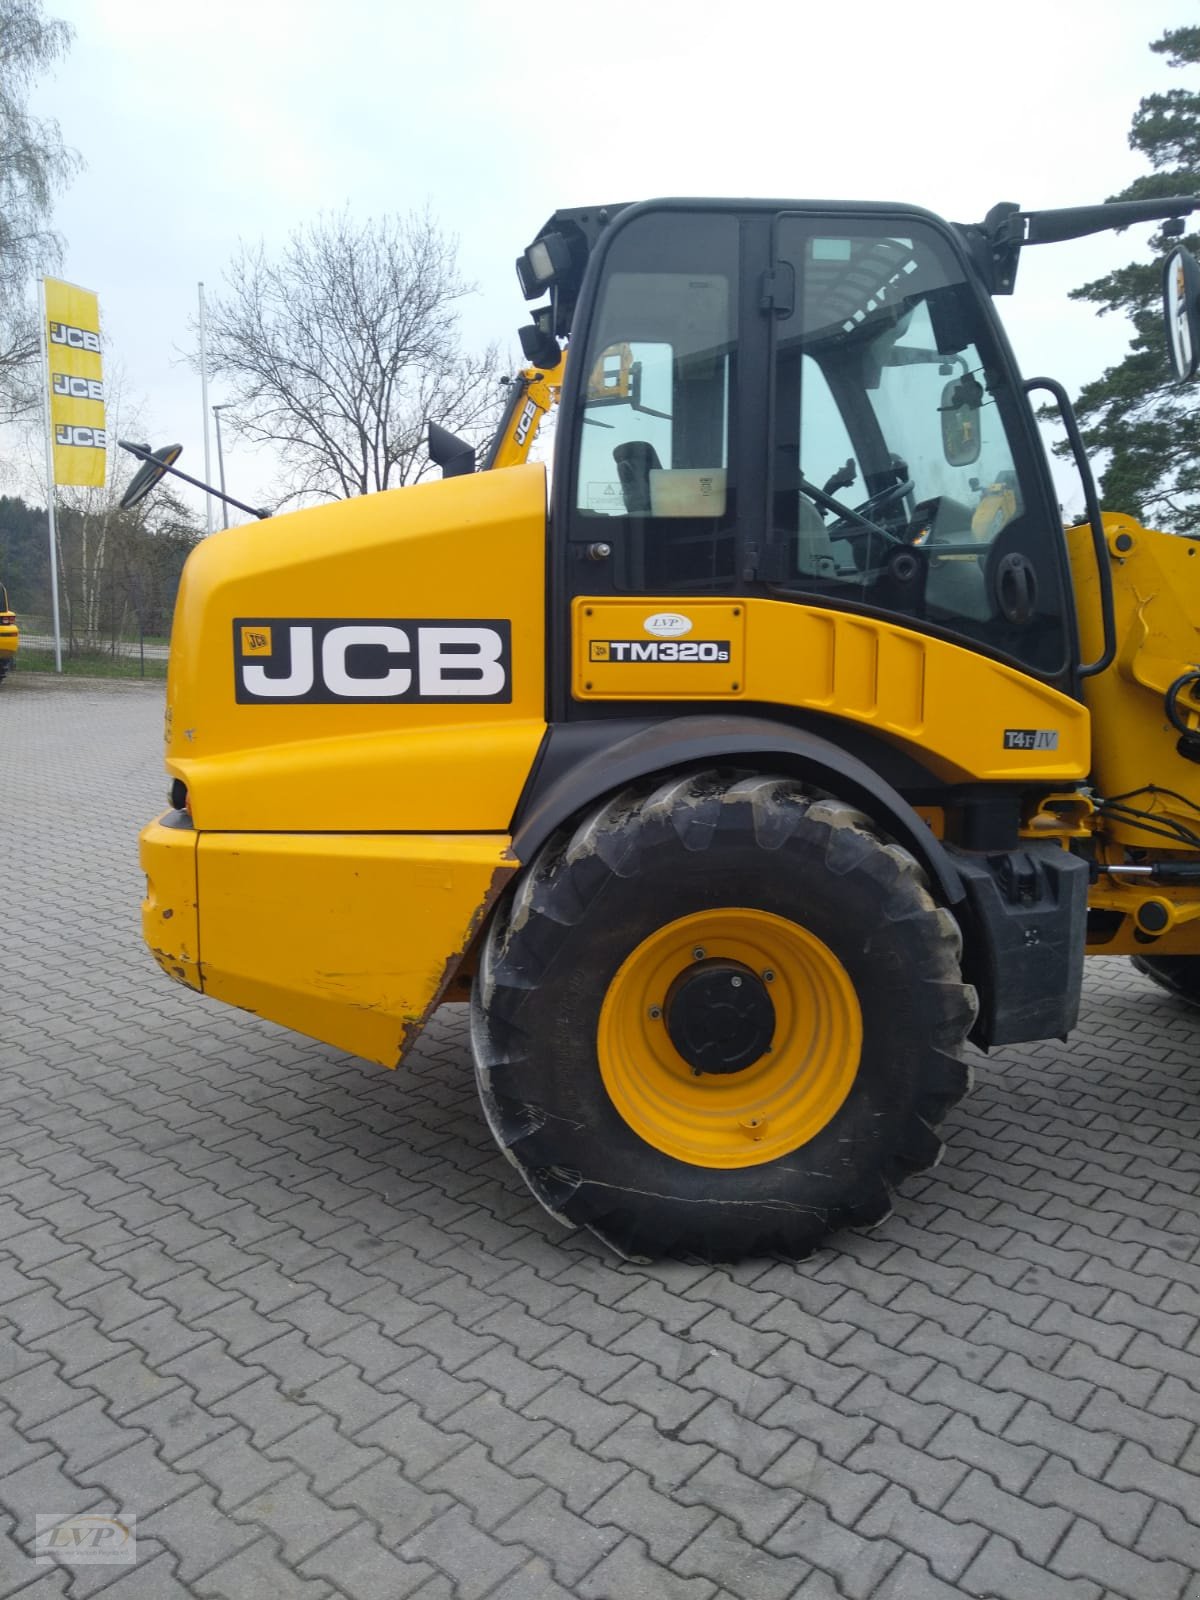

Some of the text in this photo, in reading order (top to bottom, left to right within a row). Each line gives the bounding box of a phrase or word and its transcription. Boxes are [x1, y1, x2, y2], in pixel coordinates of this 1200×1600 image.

[51, 325, 100, 353] JCB
[54, 376, 104, 400] JCB
[517, 400, 537, 445] JCB
[653, 618, 679, 627] LVP
[248, 633, 266, 649] JCB
[242, 626, 505, 697] JCB
